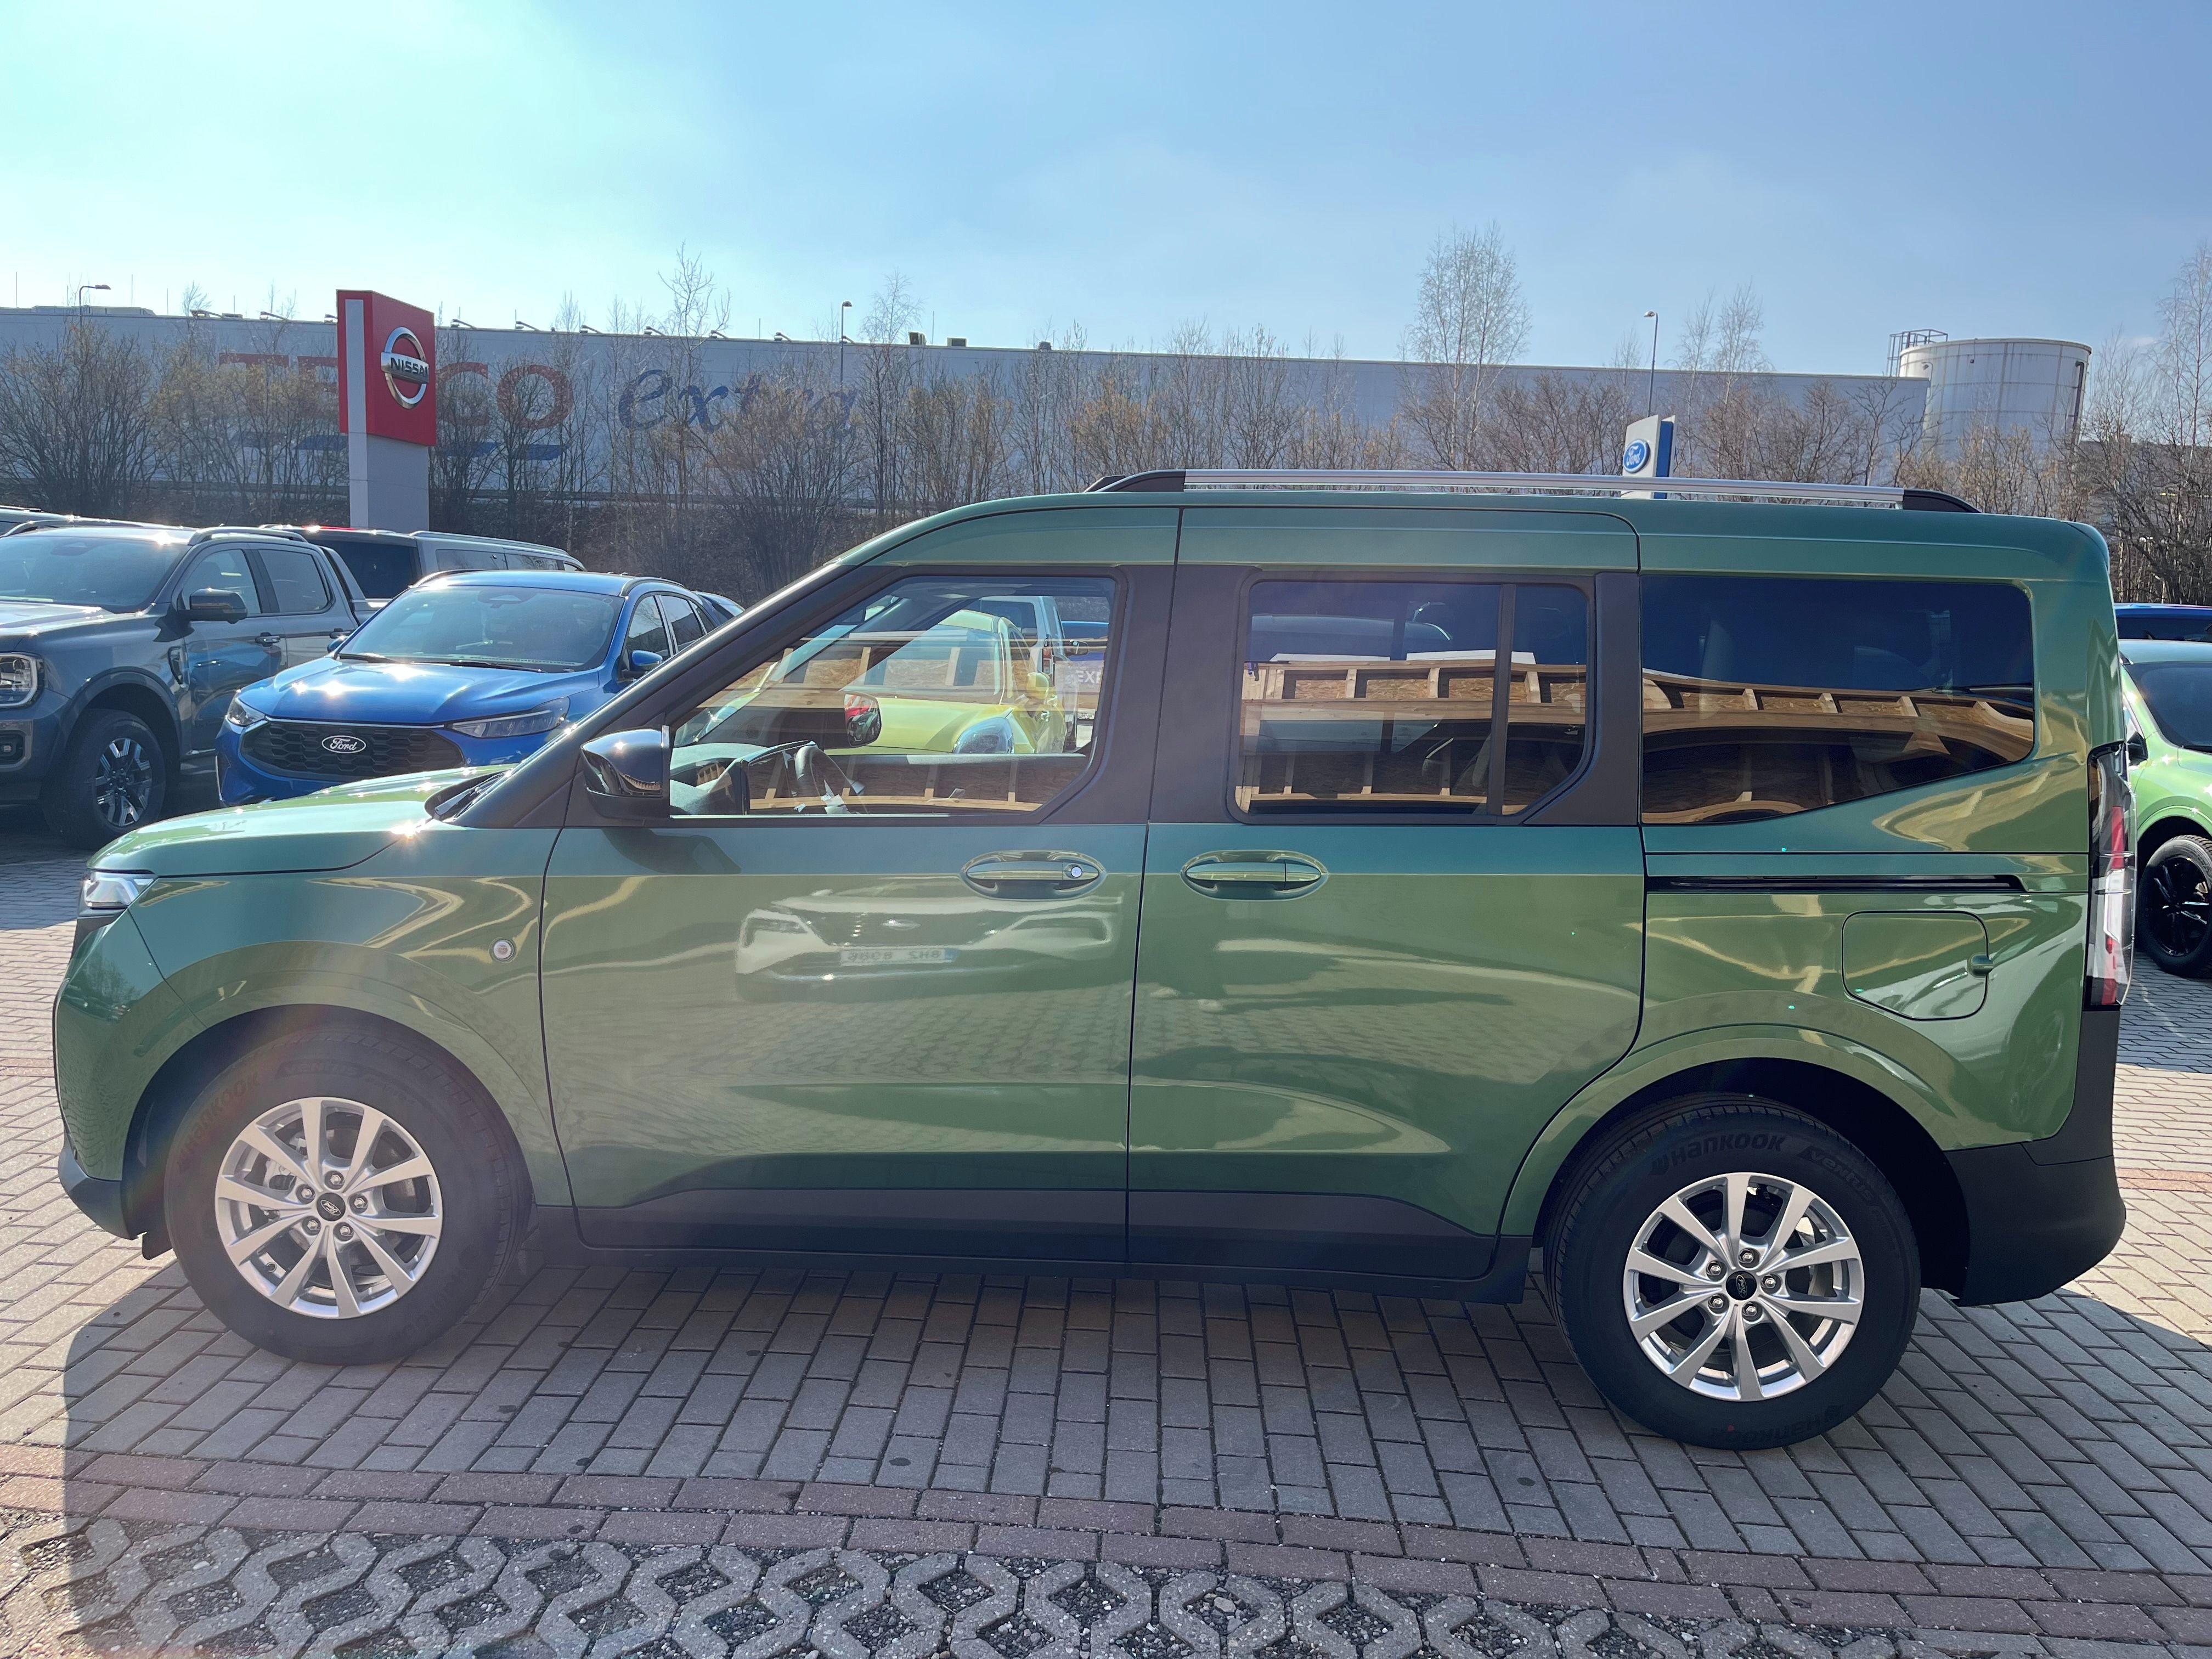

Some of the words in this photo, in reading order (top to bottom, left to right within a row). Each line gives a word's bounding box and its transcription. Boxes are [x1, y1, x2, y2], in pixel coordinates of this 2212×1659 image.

[219, 353, 573, 430] TECO
[1626, 445, 1641, 466] Ford
[330, 737, 358, 751] Ford
[324, 1203, 338, 1214] Ford
